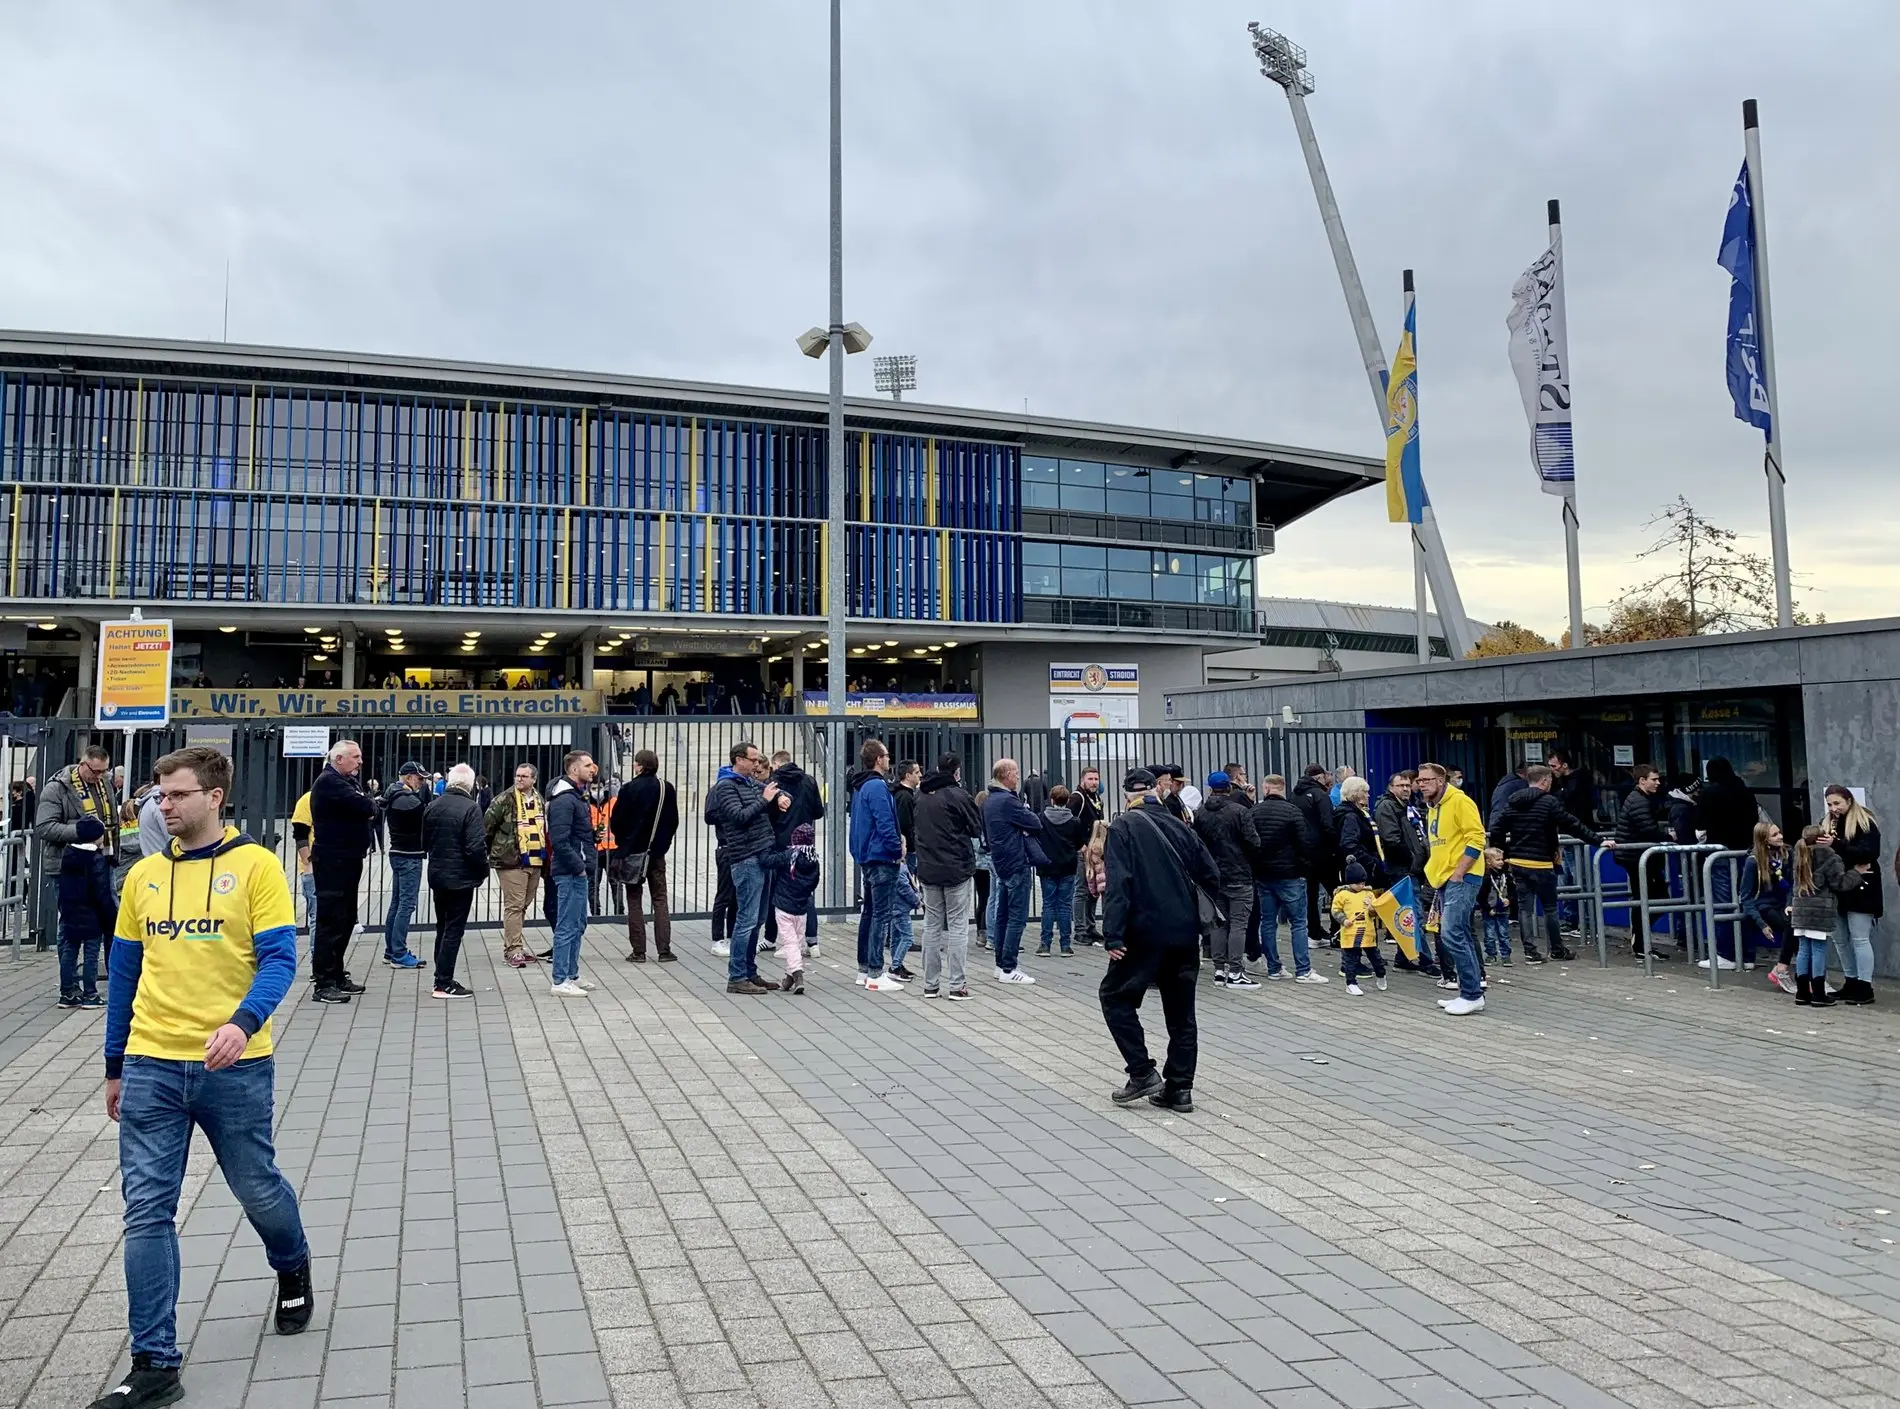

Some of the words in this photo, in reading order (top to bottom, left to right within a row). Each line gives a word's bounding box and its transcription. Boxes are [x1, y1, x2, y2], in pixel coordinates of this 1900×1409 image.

[107, 629, 166, 638] ACHTUNG!
[135, 642, 163, 650] JETZT!
[640, 637, 649, 651] 3
[748, 640, 758, 652] 4
[1053, 671, 1080, 679] EINTRACHT
[1109, 670, 1135, 679] STADION
[171, 693, 199, 716] ir,
[210, 693, 266, 716] Wir,
[277, 693, 327, 713] Wir
[336, 693, 396, 714] sind
[406, 693, 448, 713] die
[458, 694, 588, 713] Eintracht.
[146, 917, 225, 940] heycar
[281, 1296, 305, 1309] PUMA
